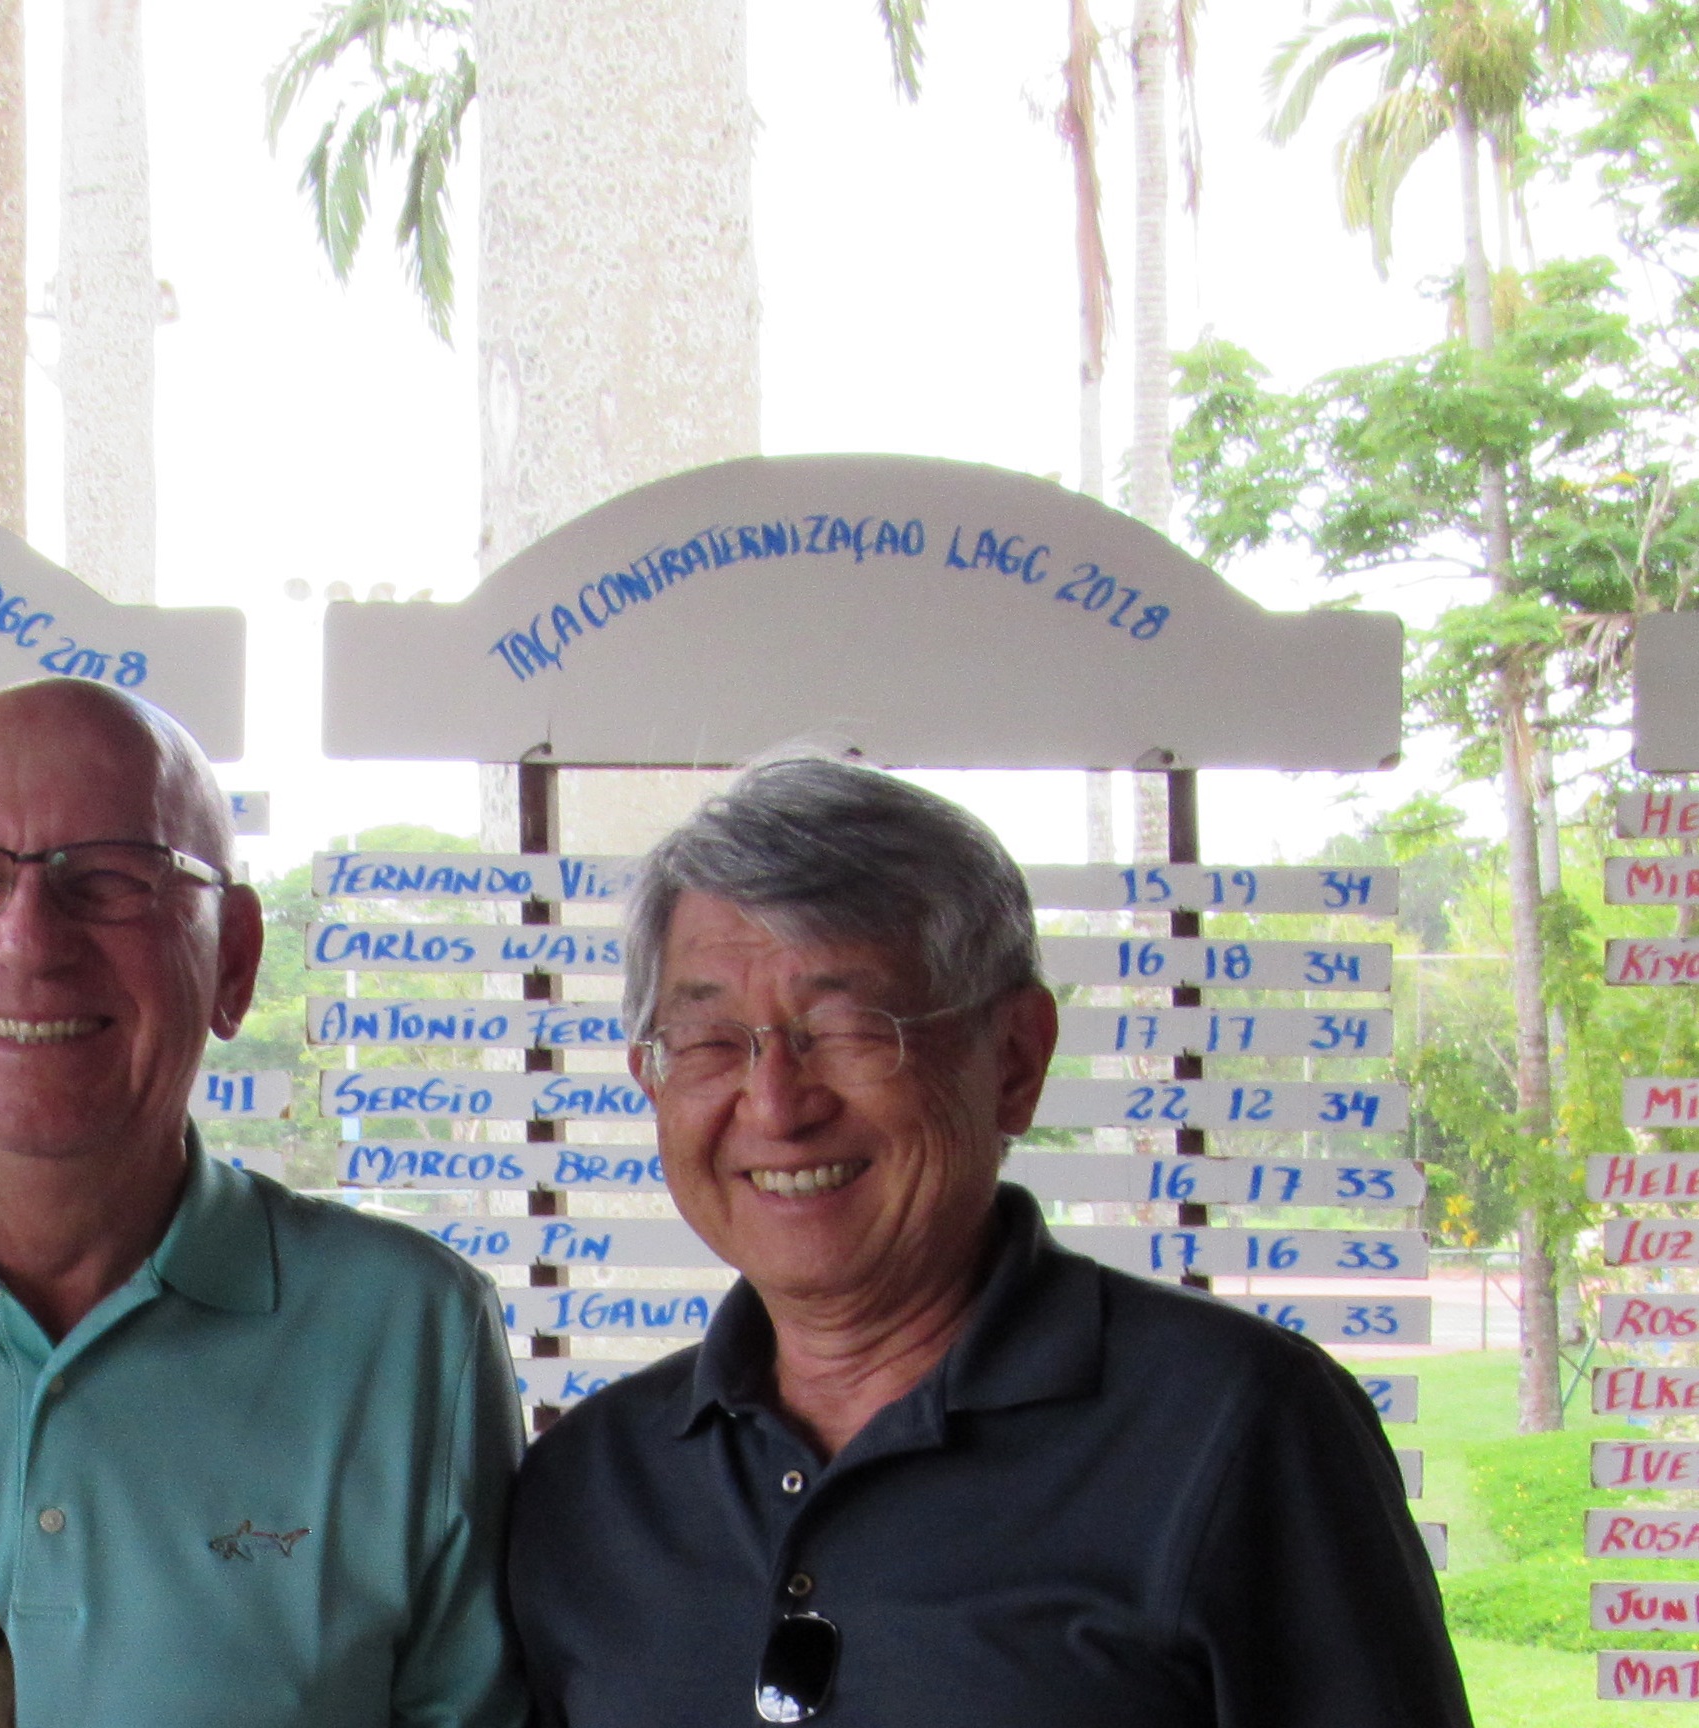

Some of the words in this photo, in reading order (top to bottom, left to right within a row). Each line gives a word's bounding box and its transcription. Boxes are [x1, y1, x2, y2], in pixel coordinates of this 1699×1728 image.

[945, 525, 1051, 584] LAGC
[1055, 562, 1170, 640] 2018
[327, 853, 533, 896] FERNANDO
[1118, 868, 1172, 906] 15
[1203, 869, 1258, 906] 19
[1318, 870, 1372, 908] 34
[315, 923, 476, 964] CARLOS
[1118, 940, 1165, 979] 16
[1204, 943, 1253, 981] 18
[1303, 949, 1362, 984] 34
[1114, 1014, 1159, 1052] 17
[1205, 1014, 1256, 1053] 17
[1308, 1014, 1369, 1052] 34
[206, 1075, 255, 1112] 41
[1124, 1086, 1190, 1122] 22
[1228, 1087, 1274, 1122] 12
[1318, 1090, 1380, 1128] 34
[348, 1145, 525, 1182] MARCOS
[1148, 1160, 1197, 1201] 16
[1247, 1164, 1302, 1202] 17
[1336, 1167, 1396, 1200] 33
[1150, 1232, 1200, 1271] 17
[1246, 1236, 1300, 1270] 16
[1336, 1241, 1400, 1271] 33
[548, 1290, 709, 1330] IGAWA
[1341, 1305, 1399, 1337] 33
